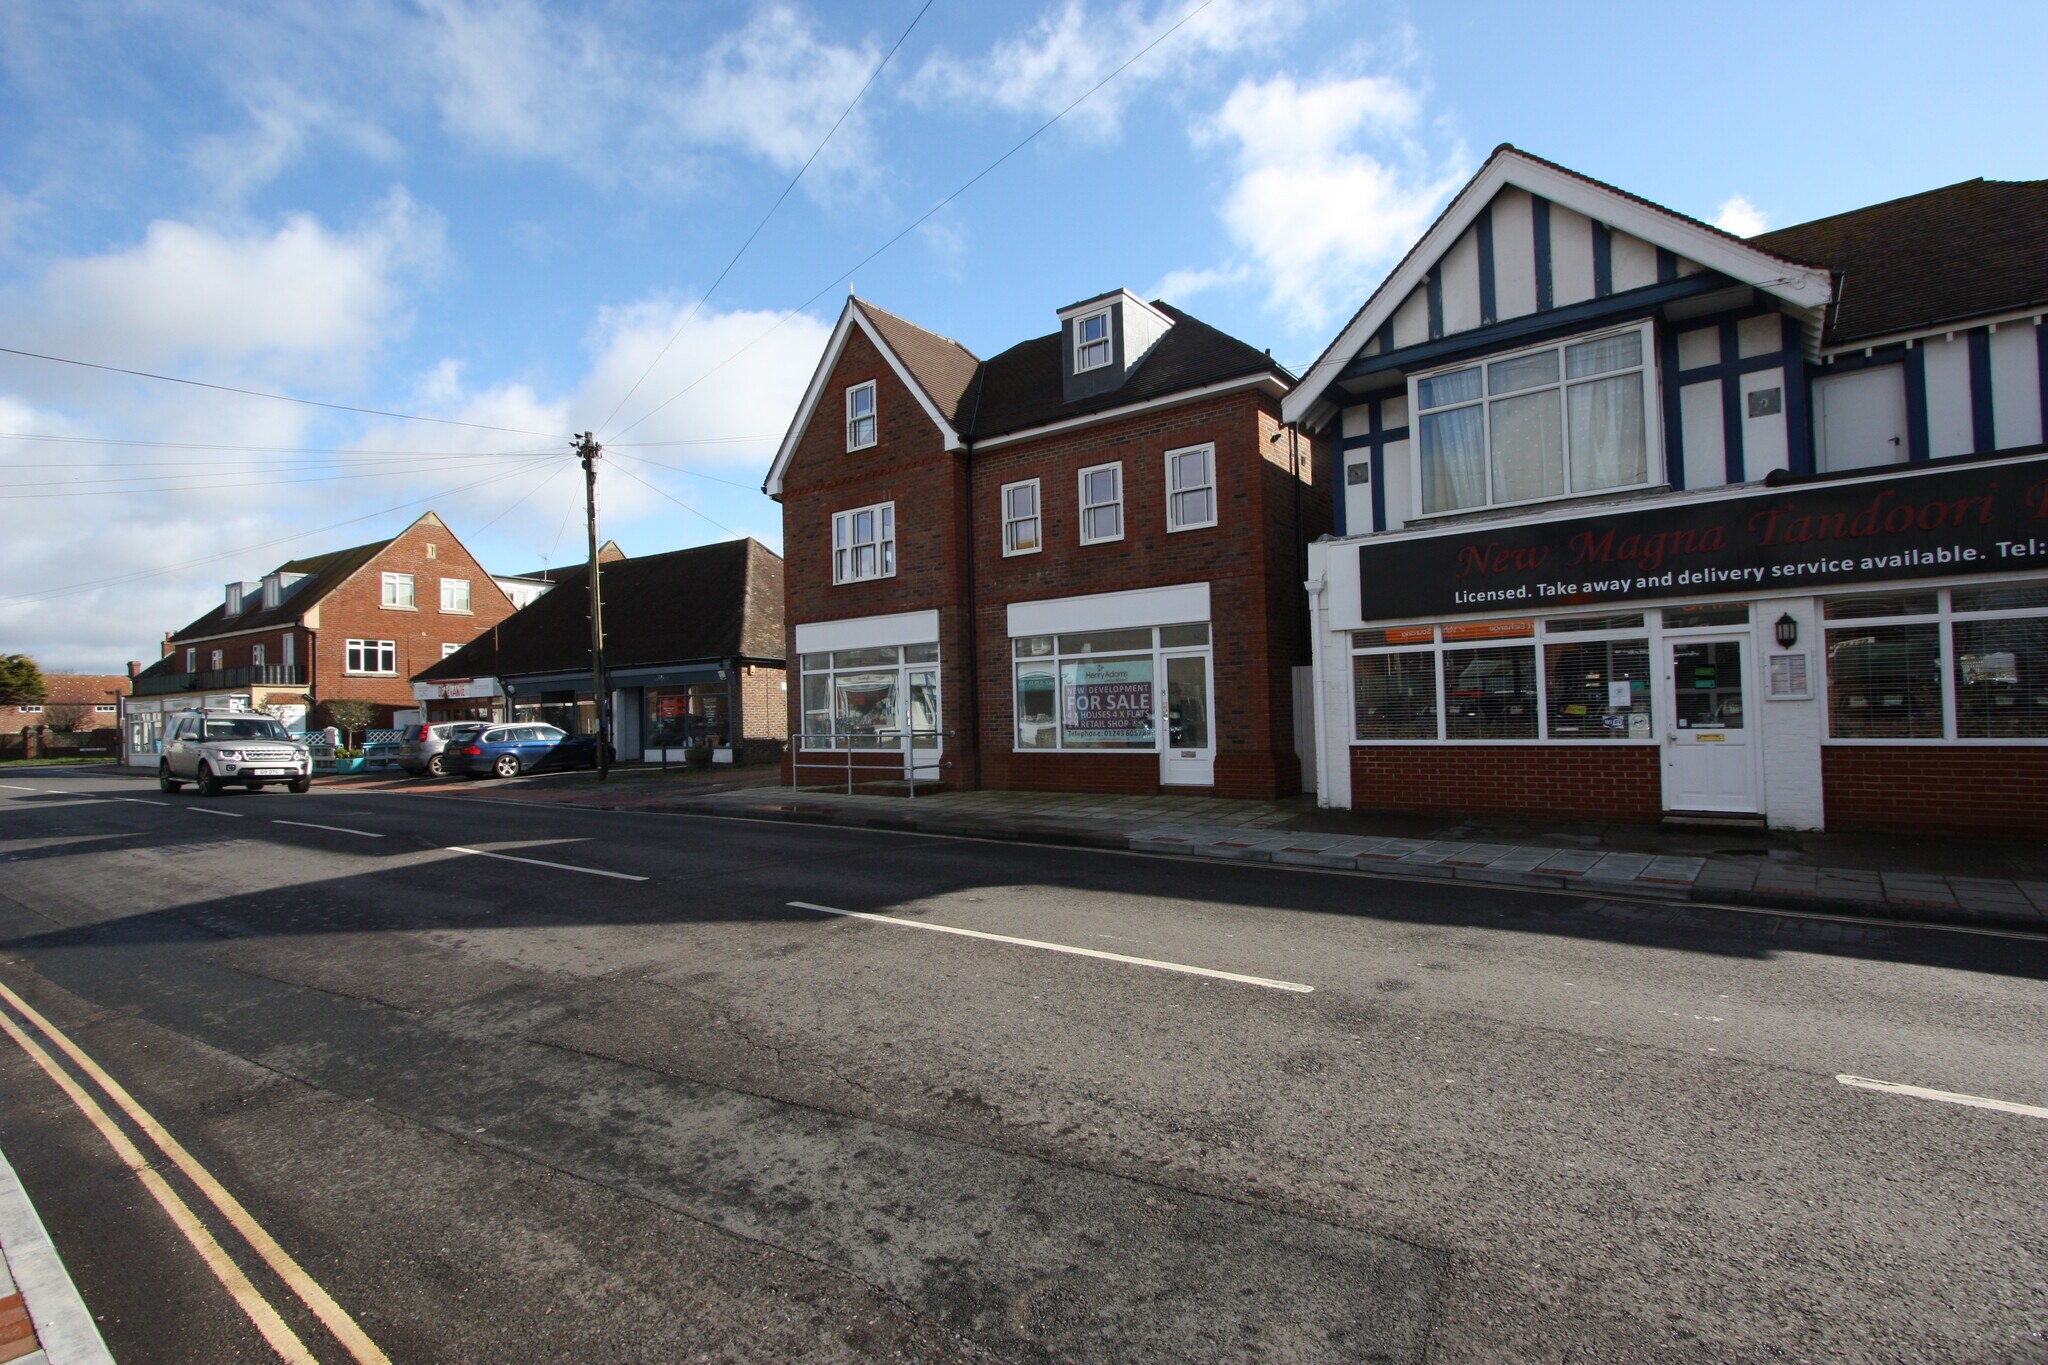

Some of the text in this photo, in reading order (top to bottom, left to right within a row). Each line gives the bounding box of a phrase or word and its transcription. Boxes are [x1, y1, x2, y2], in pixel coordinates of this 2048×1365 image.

[1455, 541, 1549, 579] New
[1567, 525, 1726, 571] Magna
[1747, 482, 2000, 546] Tandoori
[1455, 538, 2046, 604] Licensed. Take away and delivery service available. Tel:
[1088, 684, 1149, 694] DEVELOPMENT
[1067, 693, 1150, 711] FOR SALE
[1080, 710, 1111, 718] HOUSES
[1127, 709, 1150, 718] FLATS
[1107, 719, 1129, 727] SHOP
